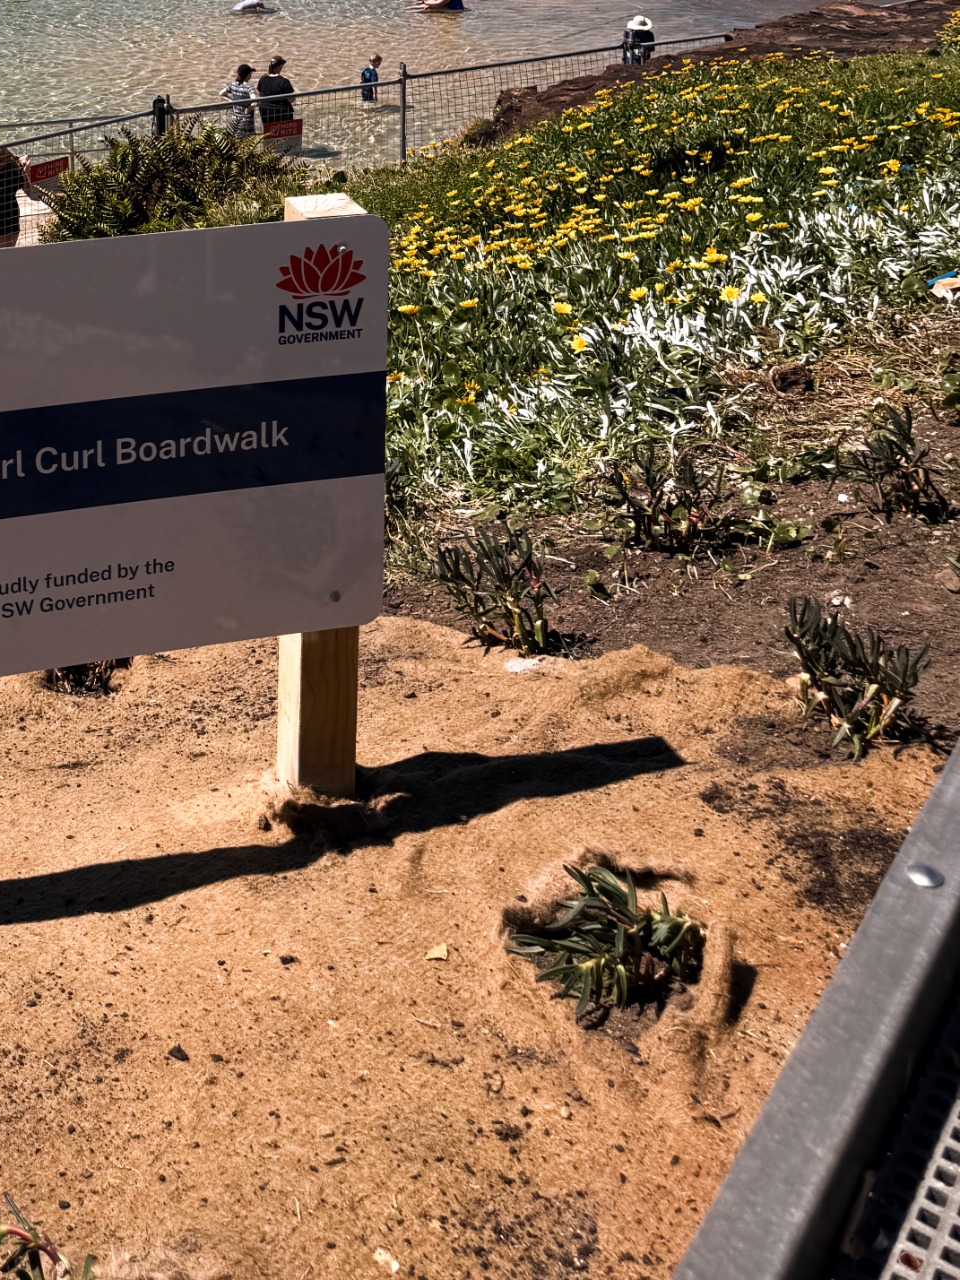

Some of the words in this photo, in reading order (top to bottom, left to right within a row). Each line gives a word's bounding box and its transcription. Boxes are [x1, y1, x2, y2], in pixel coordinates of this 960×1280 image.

[278, 297, 364, 334] NSW
[278, 328, 363, 345] GOVERNMENT
[35, 439, 106, 474] Curl
[116, 420, 289, 465] Boardwalk
[44, 564, 112, 589] funded
[117, 563, 139, 580] by
[144, 558, 175, 575] the
[40, 583, 155, 613] Government
